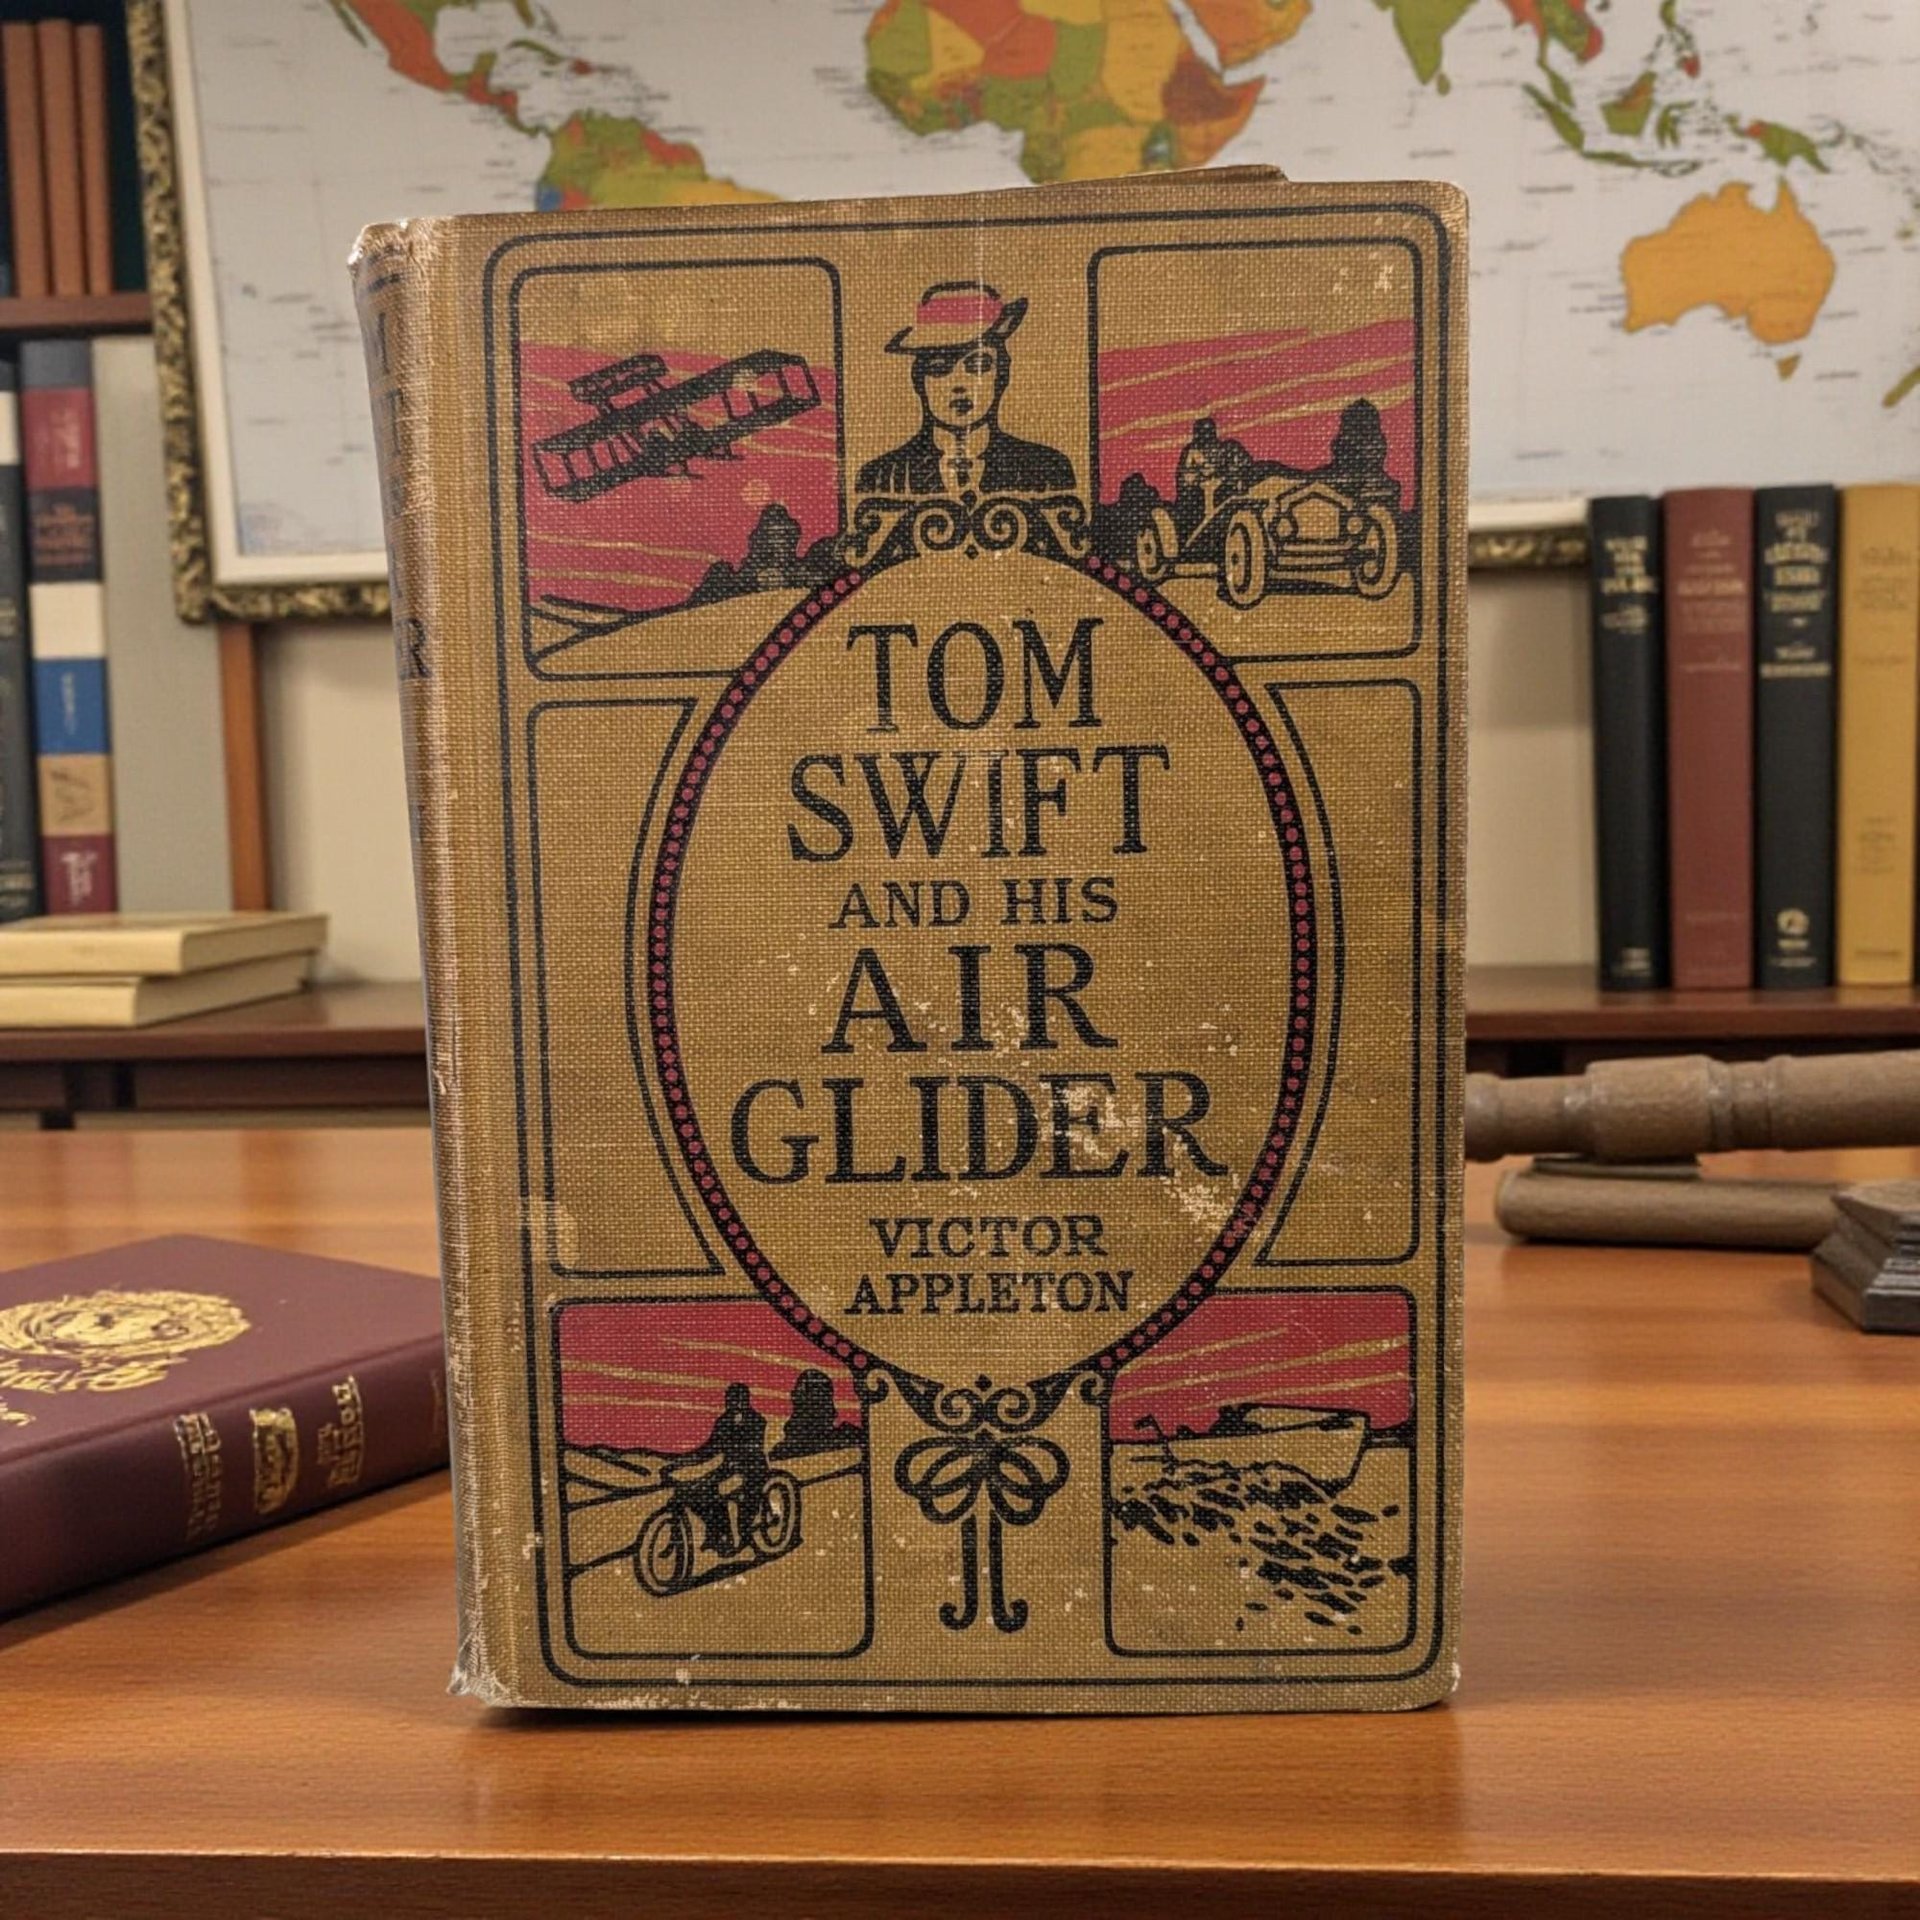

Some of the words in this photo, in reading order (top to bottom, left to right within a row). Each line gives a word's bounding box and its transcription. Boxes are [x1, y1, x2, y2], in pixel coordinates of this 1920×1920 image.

[847, 618, 1103, 733] TOM
[788, 745, 1170, 862] SWIFT
[830, 881, 970, 929] AND
[1001, 877, 1118, 925] HIS
[821, 943, 1118, 1053] AIR
[731, 1071, 1229, 1184] GLIDER
[870, 1214, 1107, 1258] VICTOR
[844, 1270, 1134, 1315] APPLETON
